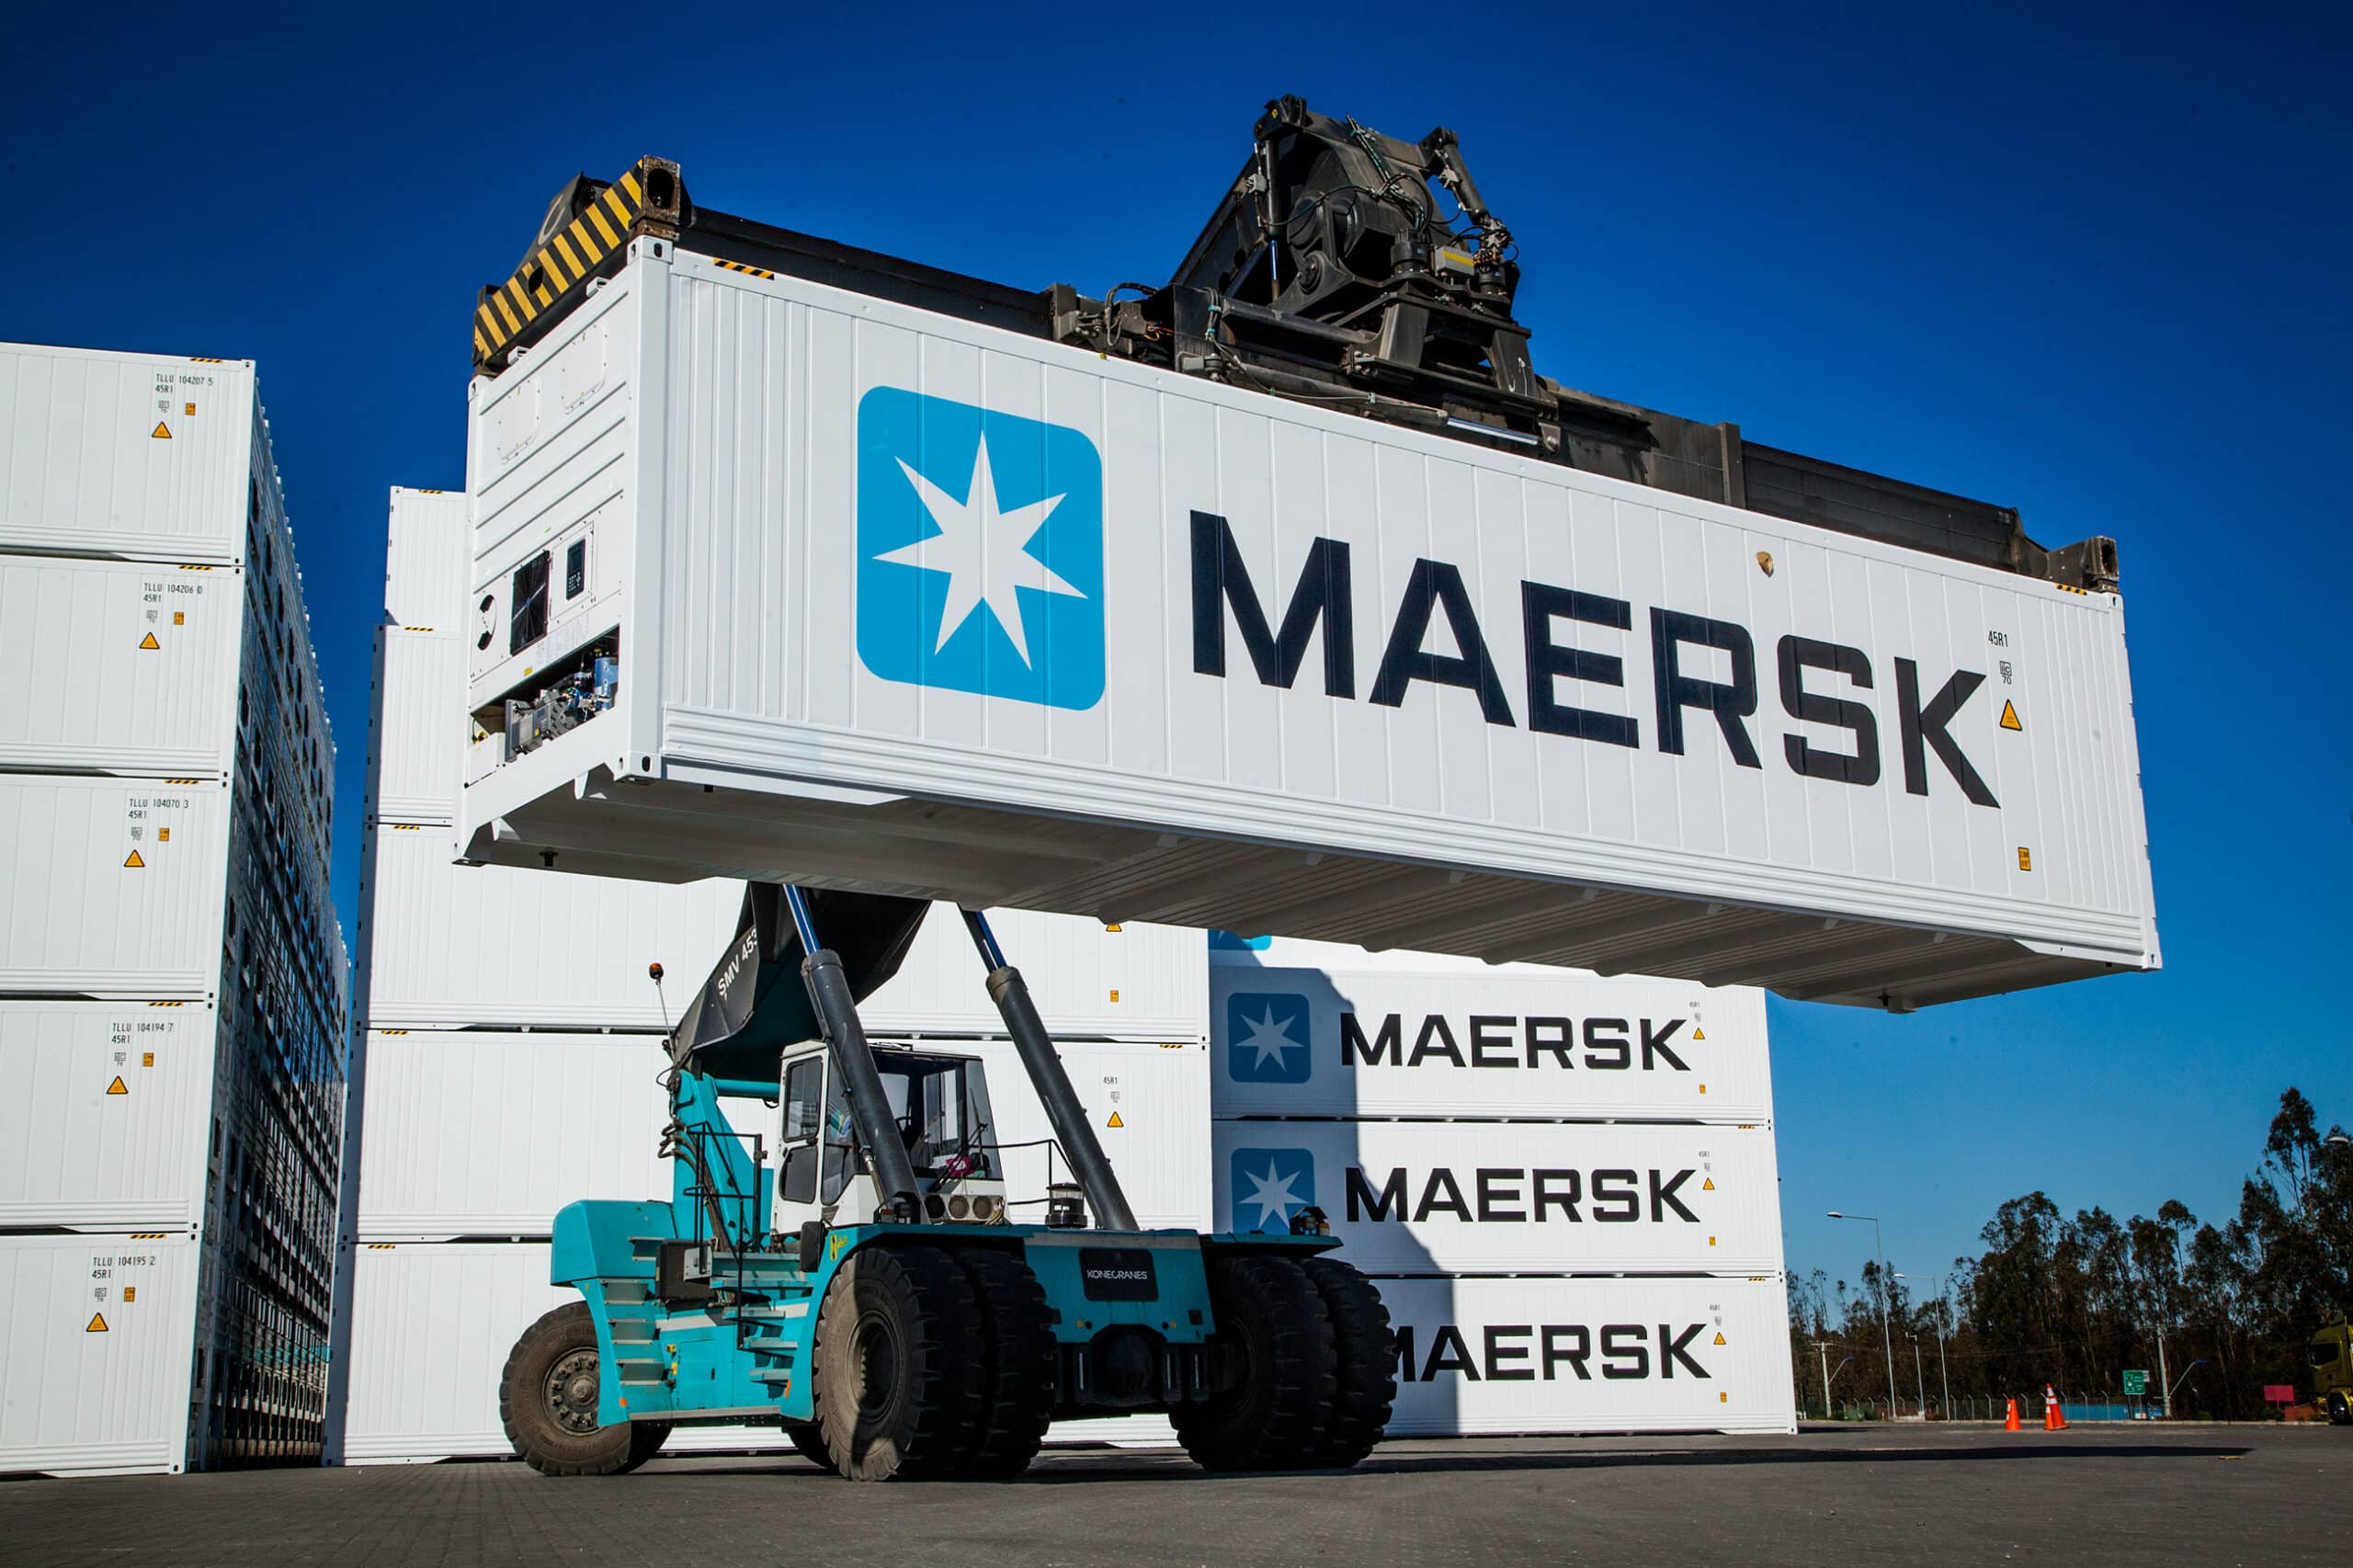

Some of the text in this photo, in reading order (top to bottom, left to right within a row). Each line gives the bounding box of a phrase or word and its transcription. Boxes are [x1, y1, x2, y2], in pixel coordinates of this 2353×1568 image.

[155, 373, 213, 386] TLLU 104207 5
[155, 384, 173, 393] 45R1
[143, 583, 202, 595] TLLU 104206 0
[143, 594, 162, 603] 45R1
[1988, 631, 2008, 647] 45R1
[1189, 509, 2001, 810] MAERSK
[2002, 676, 2012, 685] 70
[130, 798, 189, 809] TLLU 104070 3
[128, 810, 147, 819] 45R1
[717, 954, 741, 996] SMV
[112, 1022, 174, 1032] TLLU 104194 7
[111, 1035, 131, 1044] 45R1
[1339, 1012, 1691, 1071] MAERSK
[1345, 1167, 1701, 1223] MAERSK
[93, 1256, 155, 1267] TLLU 104195 2
[92, 1269, 111, 1279] 45R1
[1086, 1269, 1148, 1280] KONECRANES
